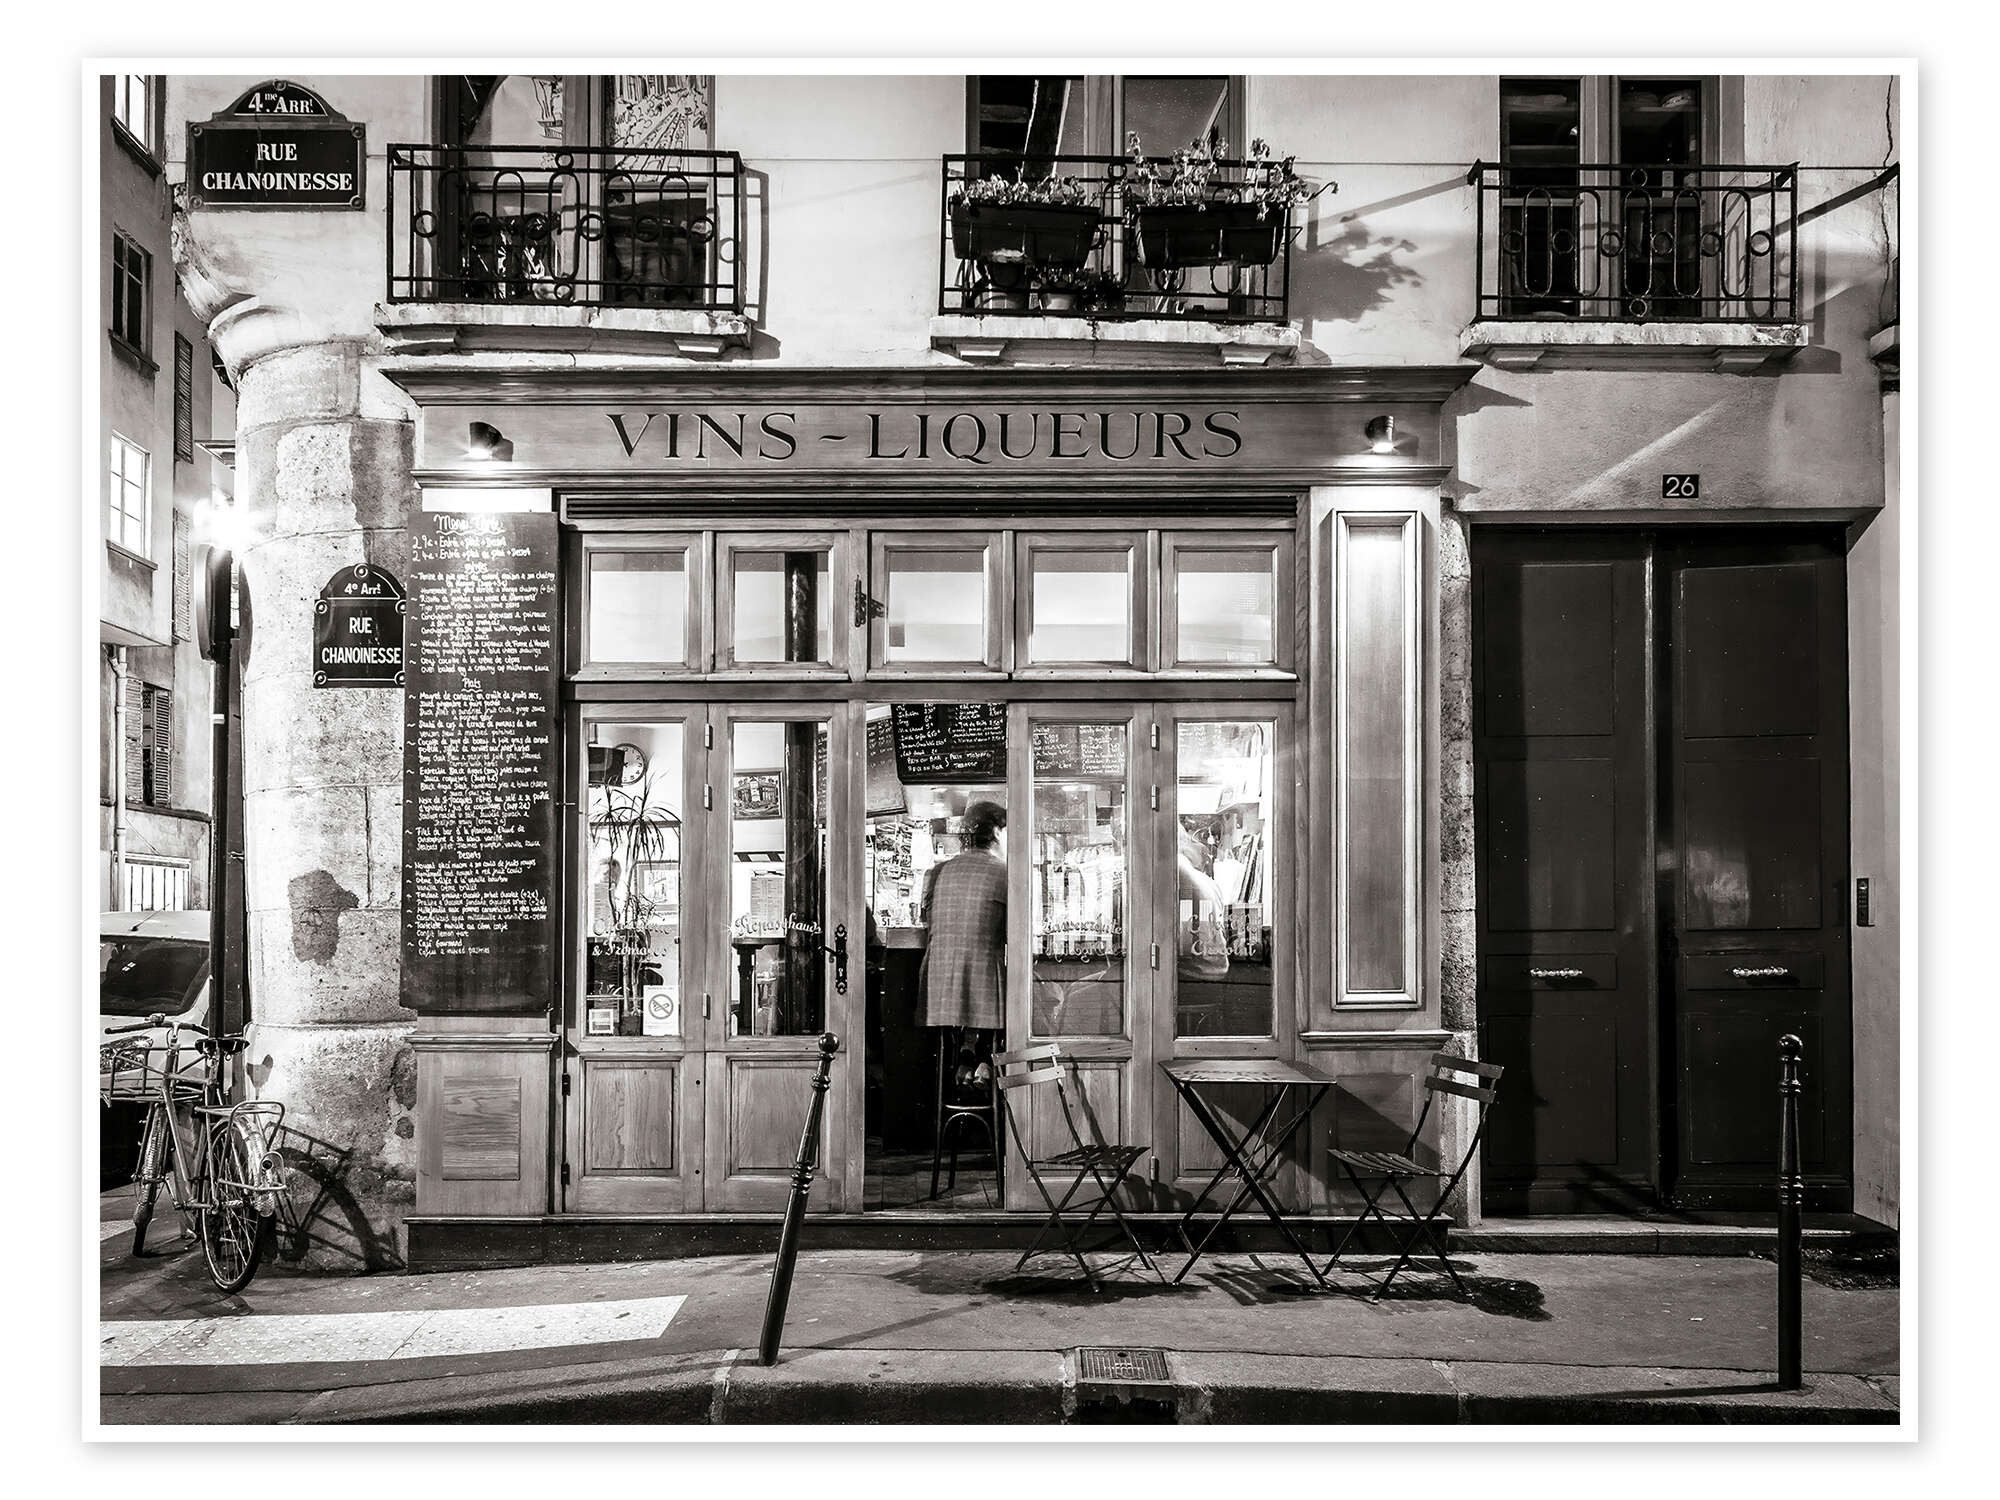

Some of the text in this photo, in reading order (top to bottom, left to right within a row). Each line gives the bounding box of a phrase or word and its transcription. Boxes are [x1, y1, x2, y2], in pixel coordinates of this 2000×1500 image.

[256, 143, 297, 161] RUE
[202, 172, 353, 191] CHANOINESSE
[606, 412, 798, 460] VINS
[864, 410, 1243, 465] LIQUEURS
[1666, 476, 1695, 497] 26
[349, 617, 373, 634] RUE
[322, 647, 402, 664] CHANOINESSE
[592, 945, 603, 956] &
